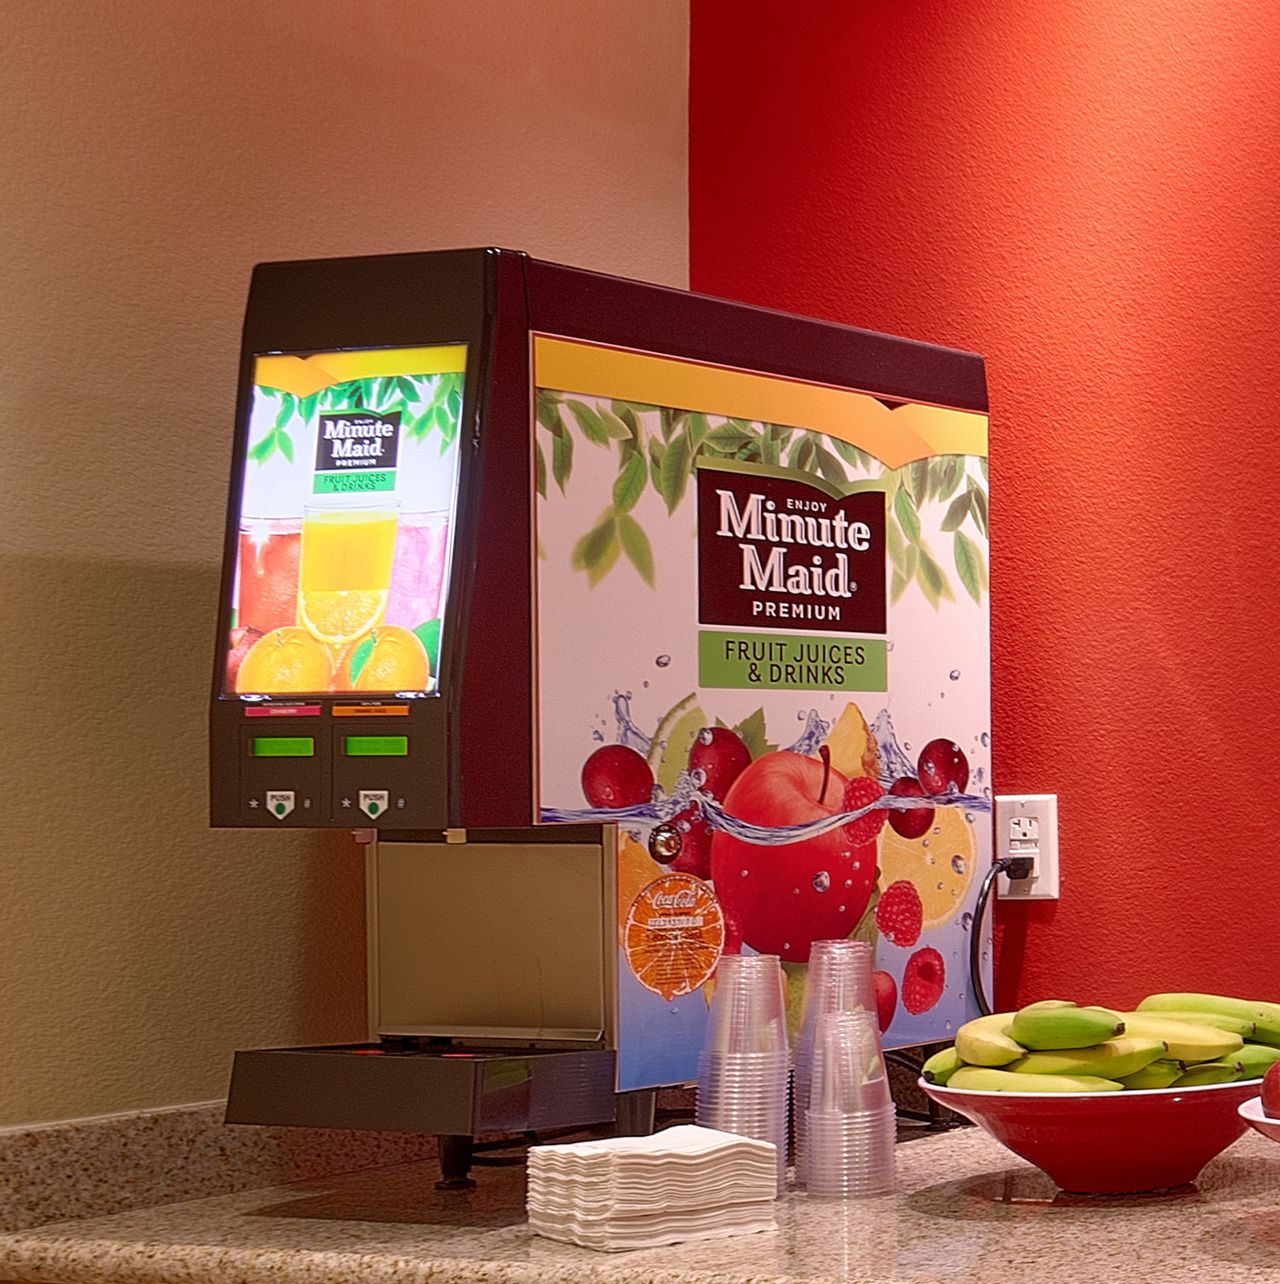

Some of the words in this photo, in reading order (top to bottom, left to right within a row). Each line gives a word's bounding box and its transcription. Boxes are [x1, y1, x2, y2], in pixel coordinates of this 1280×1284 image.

[323, 419, 394, 439] Minute
[330, 437, 383, 458] Maid
[786, 498, 828, 513] ENJOY
[715, 489, 871, 551] Minute
[738, 543, 853, 598] Maid
[752, 600, 841, 621] PREMIUM
[725, 640, 787, 662] FRUIT
[794, 643, 866, 666] JUICES
[748, 662, 762, 683] &
[770, 664, 846, 685] DRINKS
